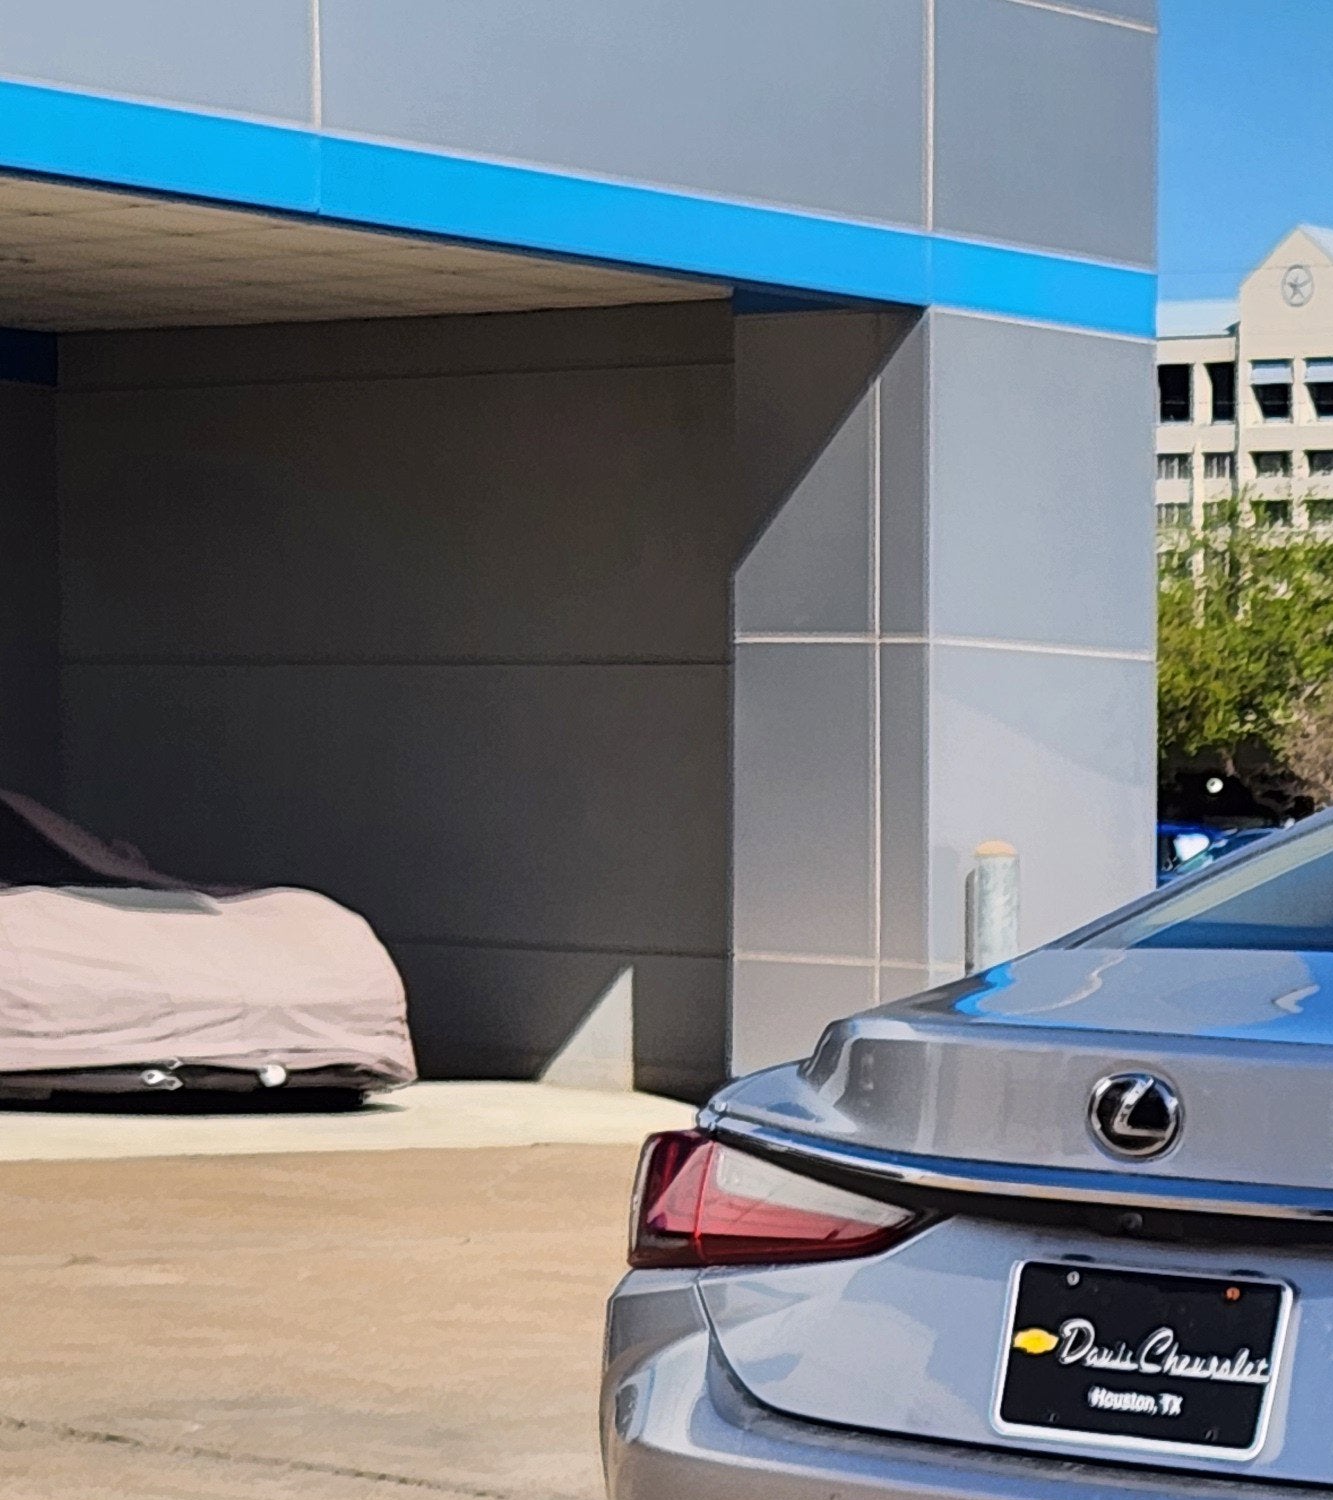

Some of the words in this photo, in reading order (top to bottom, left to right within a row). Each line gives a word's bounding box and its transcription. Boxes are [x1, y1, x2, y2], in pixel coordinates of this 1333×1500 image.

[1058, 1318, 1139, 1371] Davis
[1139, 1327, 1270, 1384] Chevrolet
[1088, 1386, 1157, 1416] Houston,
[1159, 1392, 1184, 1416] TX
